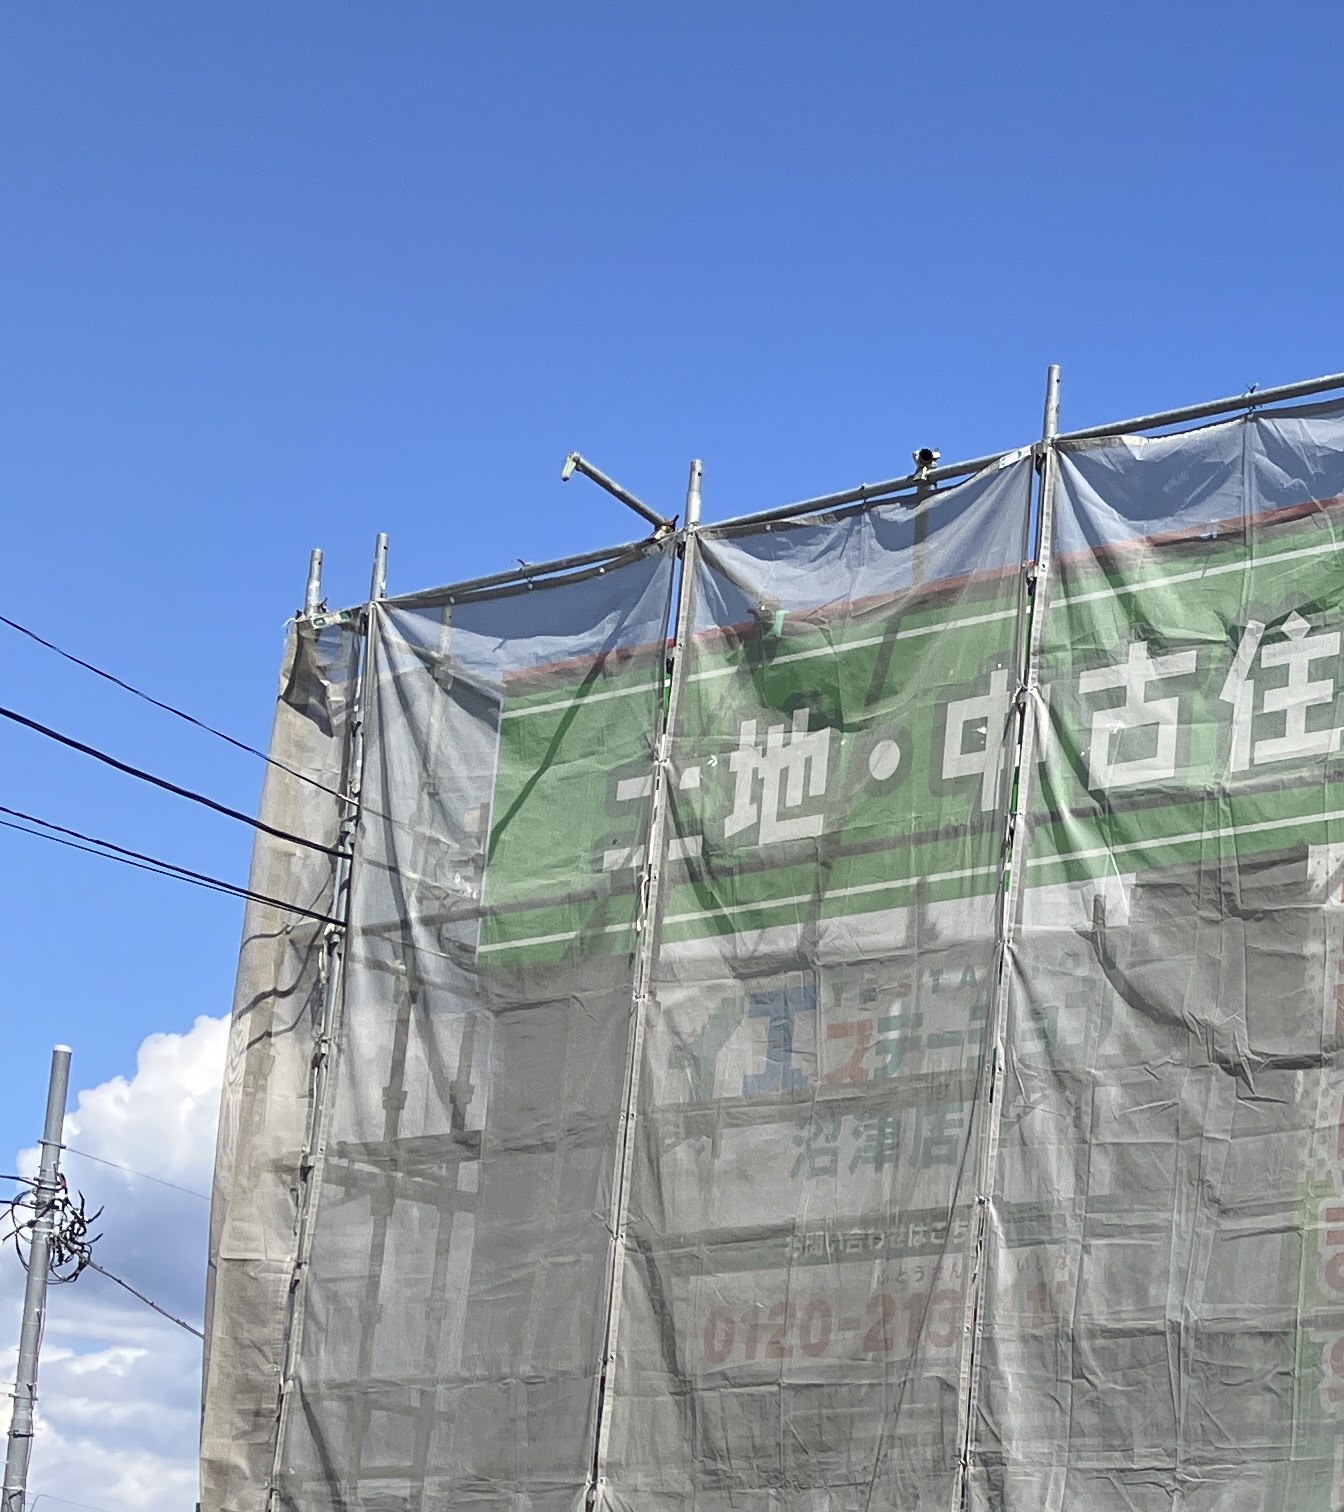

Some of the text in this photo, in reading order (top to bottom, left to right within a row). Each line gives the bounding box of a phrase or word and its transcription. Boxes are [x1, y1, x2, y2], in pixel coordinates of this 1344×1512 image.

[790, 1101, 965, 1179] 沼津店
[786, 1221, 971, 1260] お問い合わせはこち
